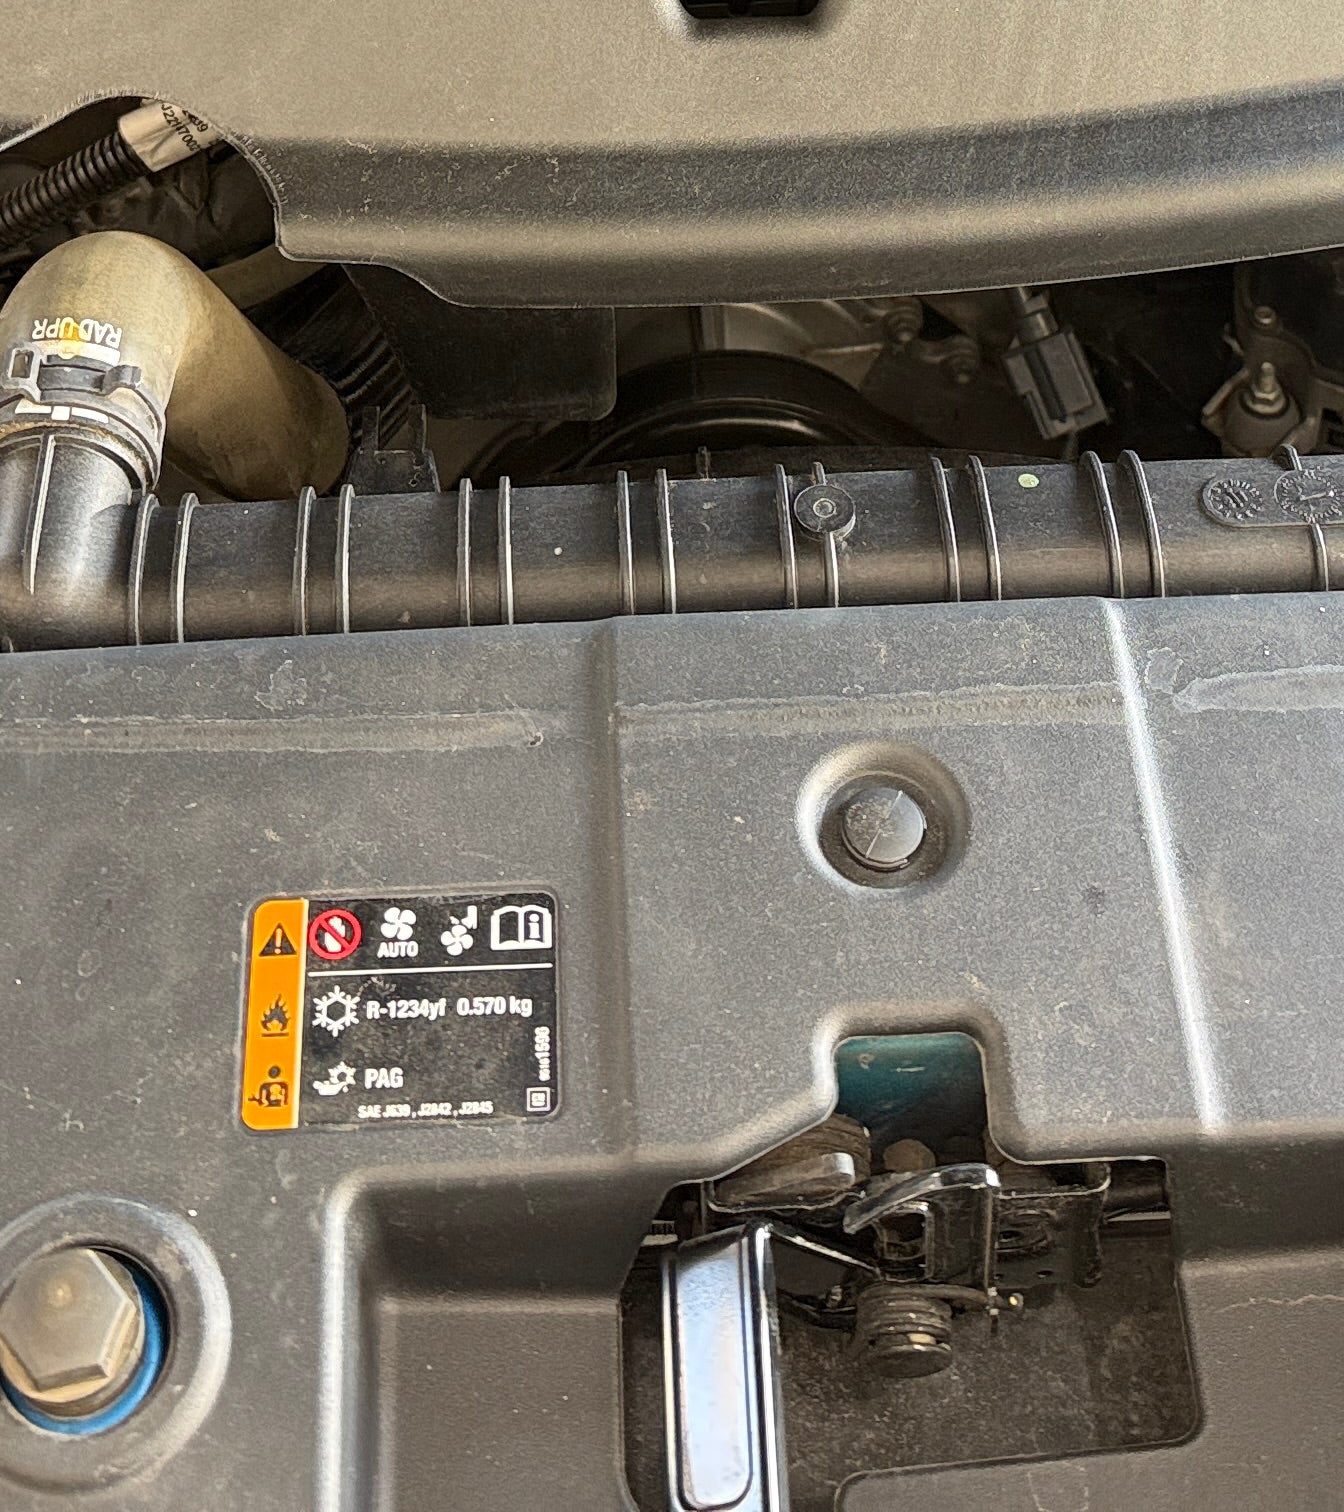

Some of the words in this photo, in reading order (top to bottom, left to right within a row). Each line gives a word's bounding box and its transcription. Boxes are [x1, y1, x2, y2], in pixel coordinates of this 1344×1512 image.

[377, 941, 419, 959] AUTO
[365, 998, 448, 1022] R-1234yf
[456, 996, 507, 1017] 0.570
[508, 996, 534, 1019] kg
[364, 1067, 404, 1090] PAG
[357, 1104, 382, 1119] SAE
